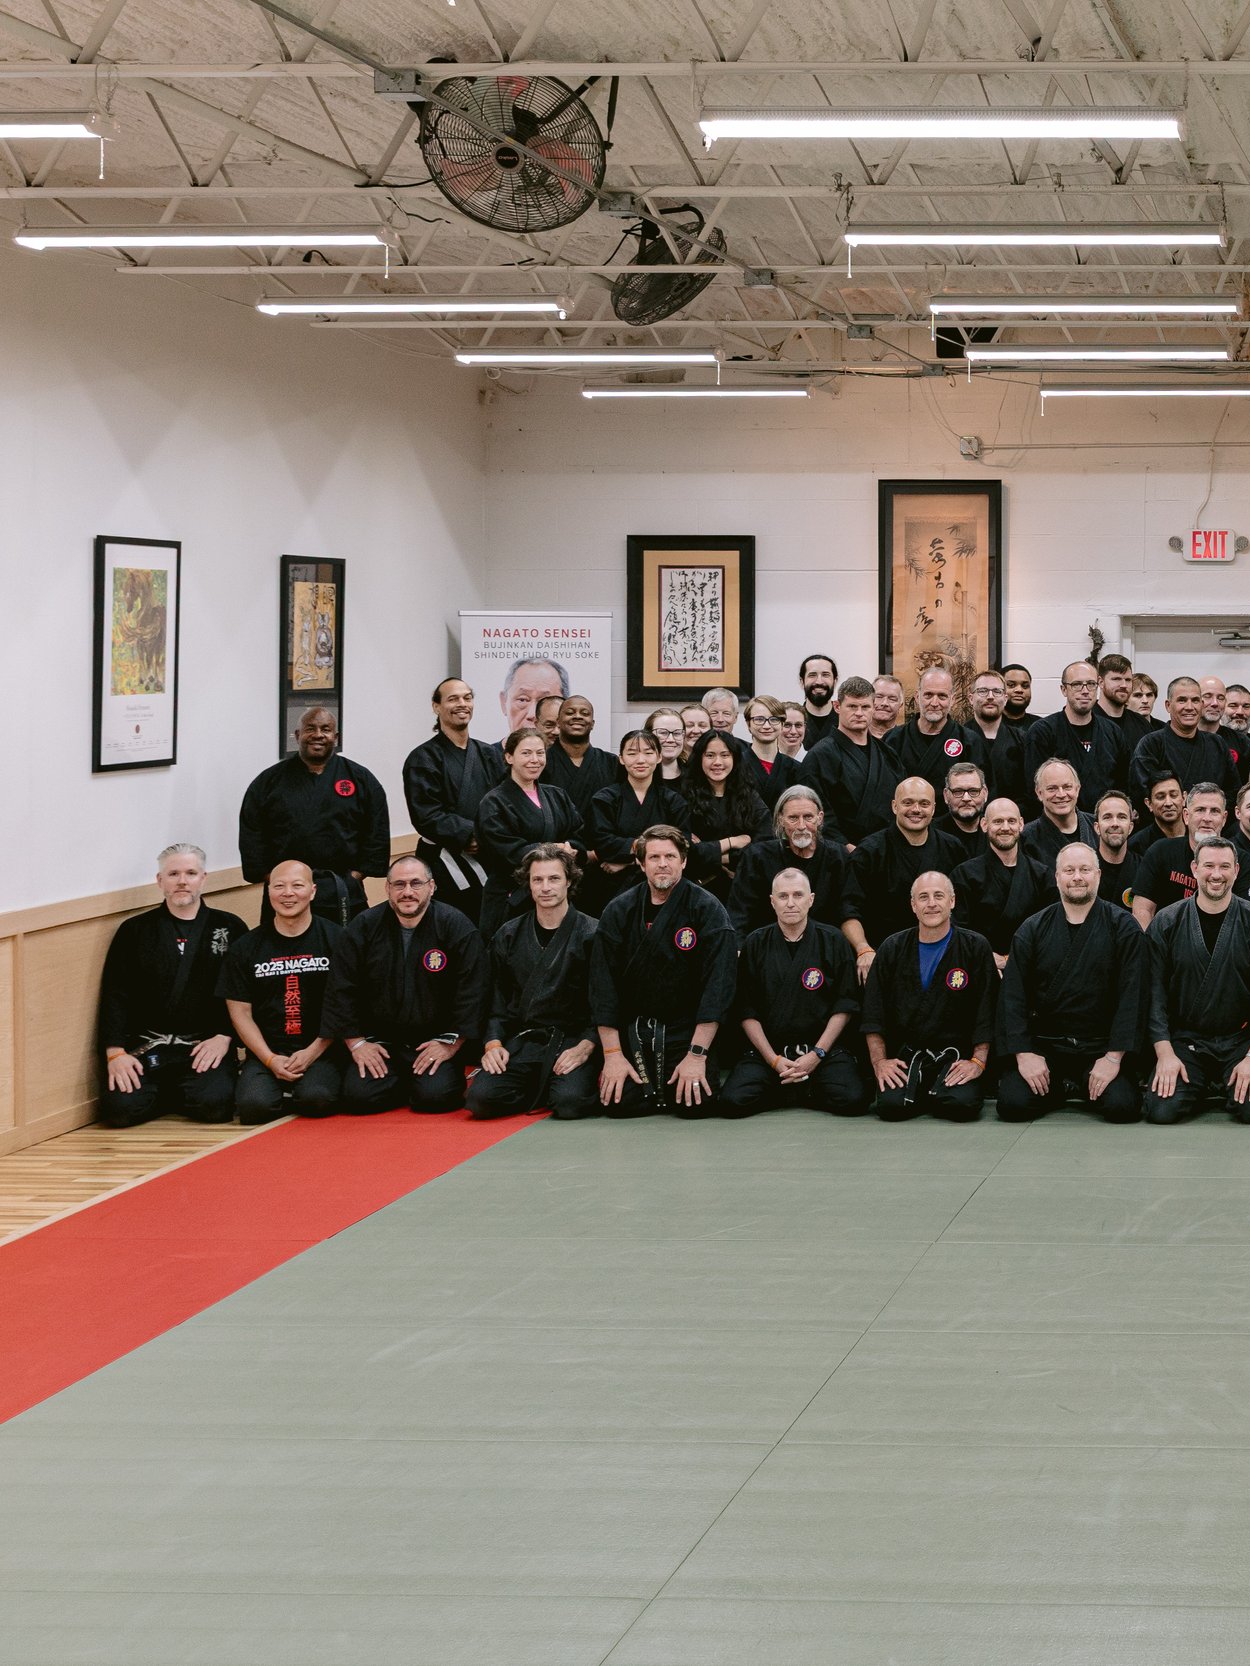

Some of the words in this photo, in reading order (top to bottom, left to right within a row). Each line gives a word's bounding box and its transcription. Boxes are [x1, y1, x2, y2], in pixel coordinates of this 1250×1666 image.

[1191, 530, 1228, 559] EXIT
[482, 628, 539, 638] NAGATO
[544, 628, 591, 638] SENSEI
[483, 641, 534, 649] BUJINKAN
[536, 641, 591, 649] DAISHIHAN
[474, 651, 519, 659] SHINDEN
[522, 651, 549, 659] FUDO
[553, 651, 571, 659] RYU
[575, 651, 600, 659] SOKE
[254, 961, 285, 974] 2025
[285, 957, 330, 970] NAGATO
[284, 974, 302, 1035] 自然至極
